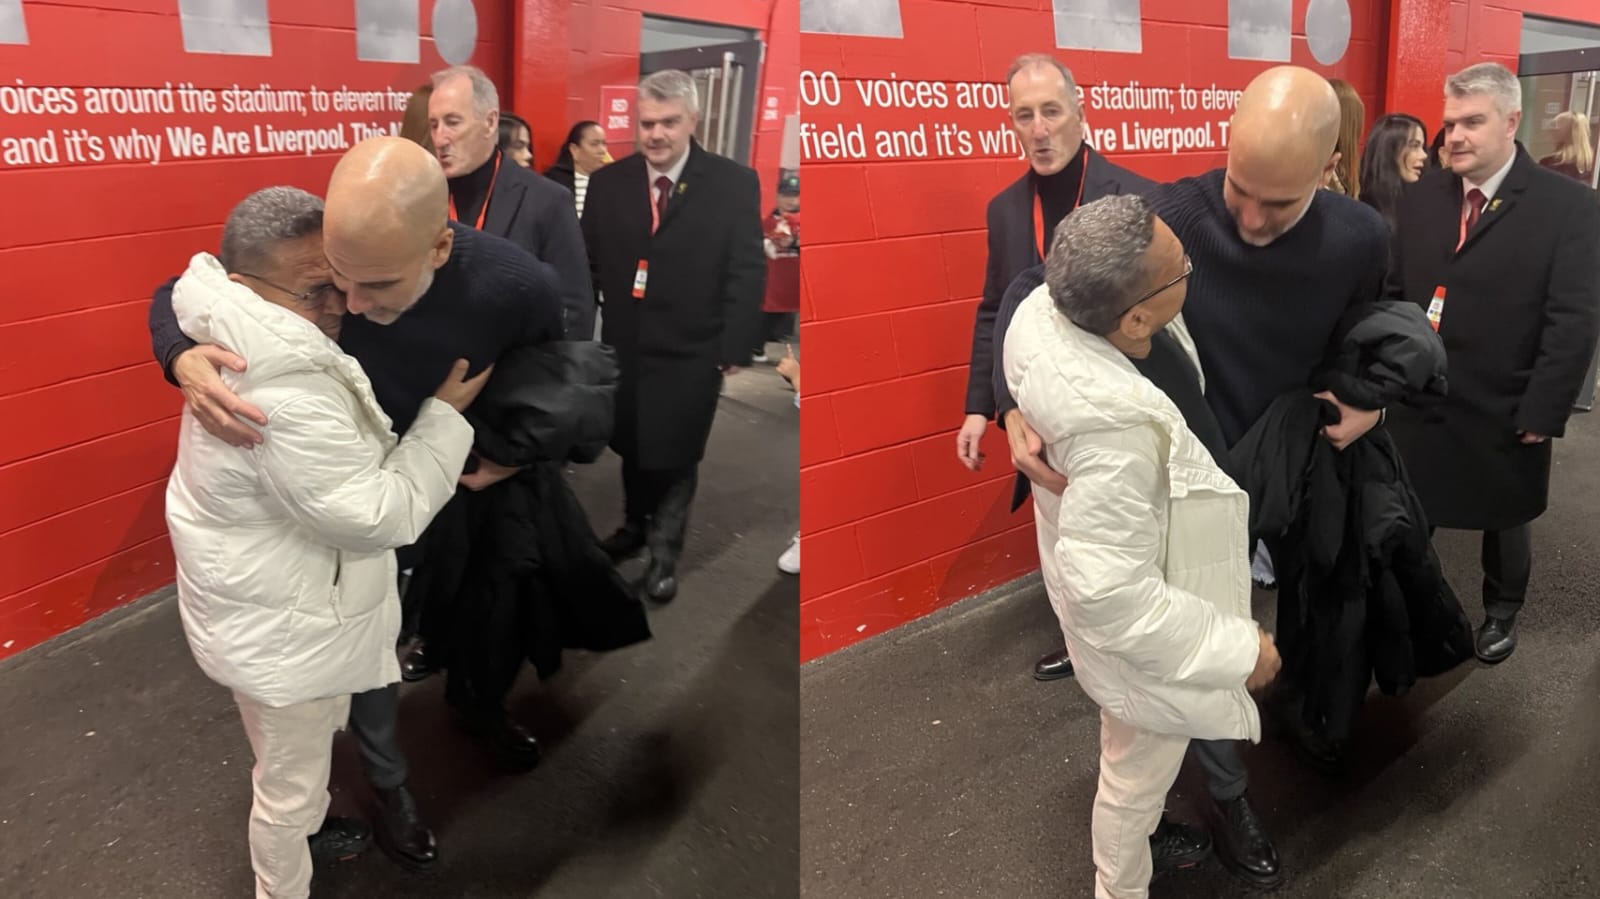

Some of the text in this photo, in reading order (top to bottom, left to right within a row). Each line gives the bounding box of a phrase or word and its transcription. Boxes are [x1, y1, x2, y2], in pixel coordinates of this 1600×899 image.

[83, 82, 175, 113] around
[177, 82, 217, 113] the
[222, 84, 308, 117] stadium;
[310, 85, 330, 112] to
[333, 85, 385, 112] eleven
[856, 73, 948, 109] voices
[1090, 81, 1175, 114] stadium;
[1178, 83, 1198, 110] to
[2, 129, 59, 165] and
[63, 128, 105, 163] it's
[108, 127, 162, 165] why
[166, 126, 207, 157] We
[211, 125, 251, 155] Are
[254, 123, 349, 157] Liverpool.
[800, 122, 866, 159] field
[875, 123, 928, 158] and
[933, 122, 973, 157] it's
[1081, 121, 1117, 151] Are
[1121, 121, 1215, 154] Liverpool.
